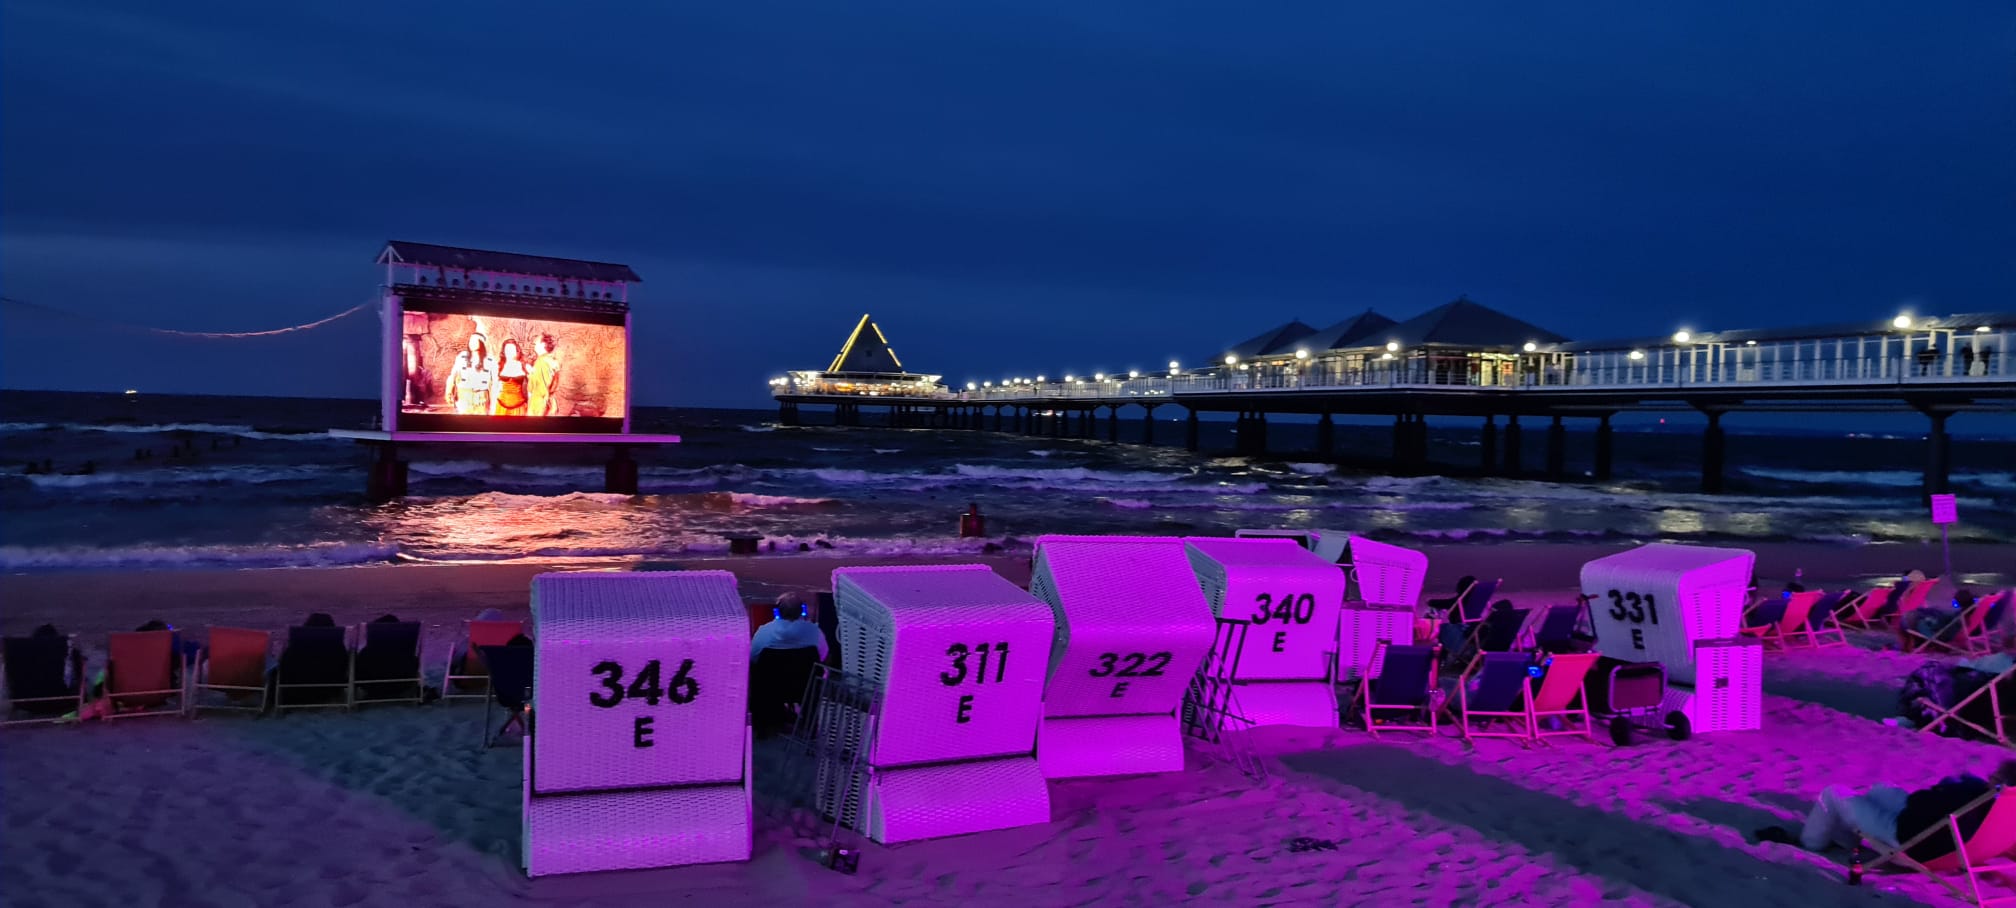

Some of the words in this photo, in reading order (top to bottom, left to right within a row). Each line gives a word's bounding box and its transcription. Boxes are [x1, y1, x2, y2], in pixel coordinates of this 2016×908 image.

[1251, 593, 1315, 625] 340
[1608, 589, 1658, 625] 331
[1272, 632, 1286, 652] E
[1631, 629, 1645, 650] E
[940, 642, 1009, 686] 311
[1089, 652, 1172, 678] 322
[591, 659, 700, 708] 346
[1110, 682, 1130, 698] E
[957, 695, 973, 723] E
[634, 717, 654, 748] E
